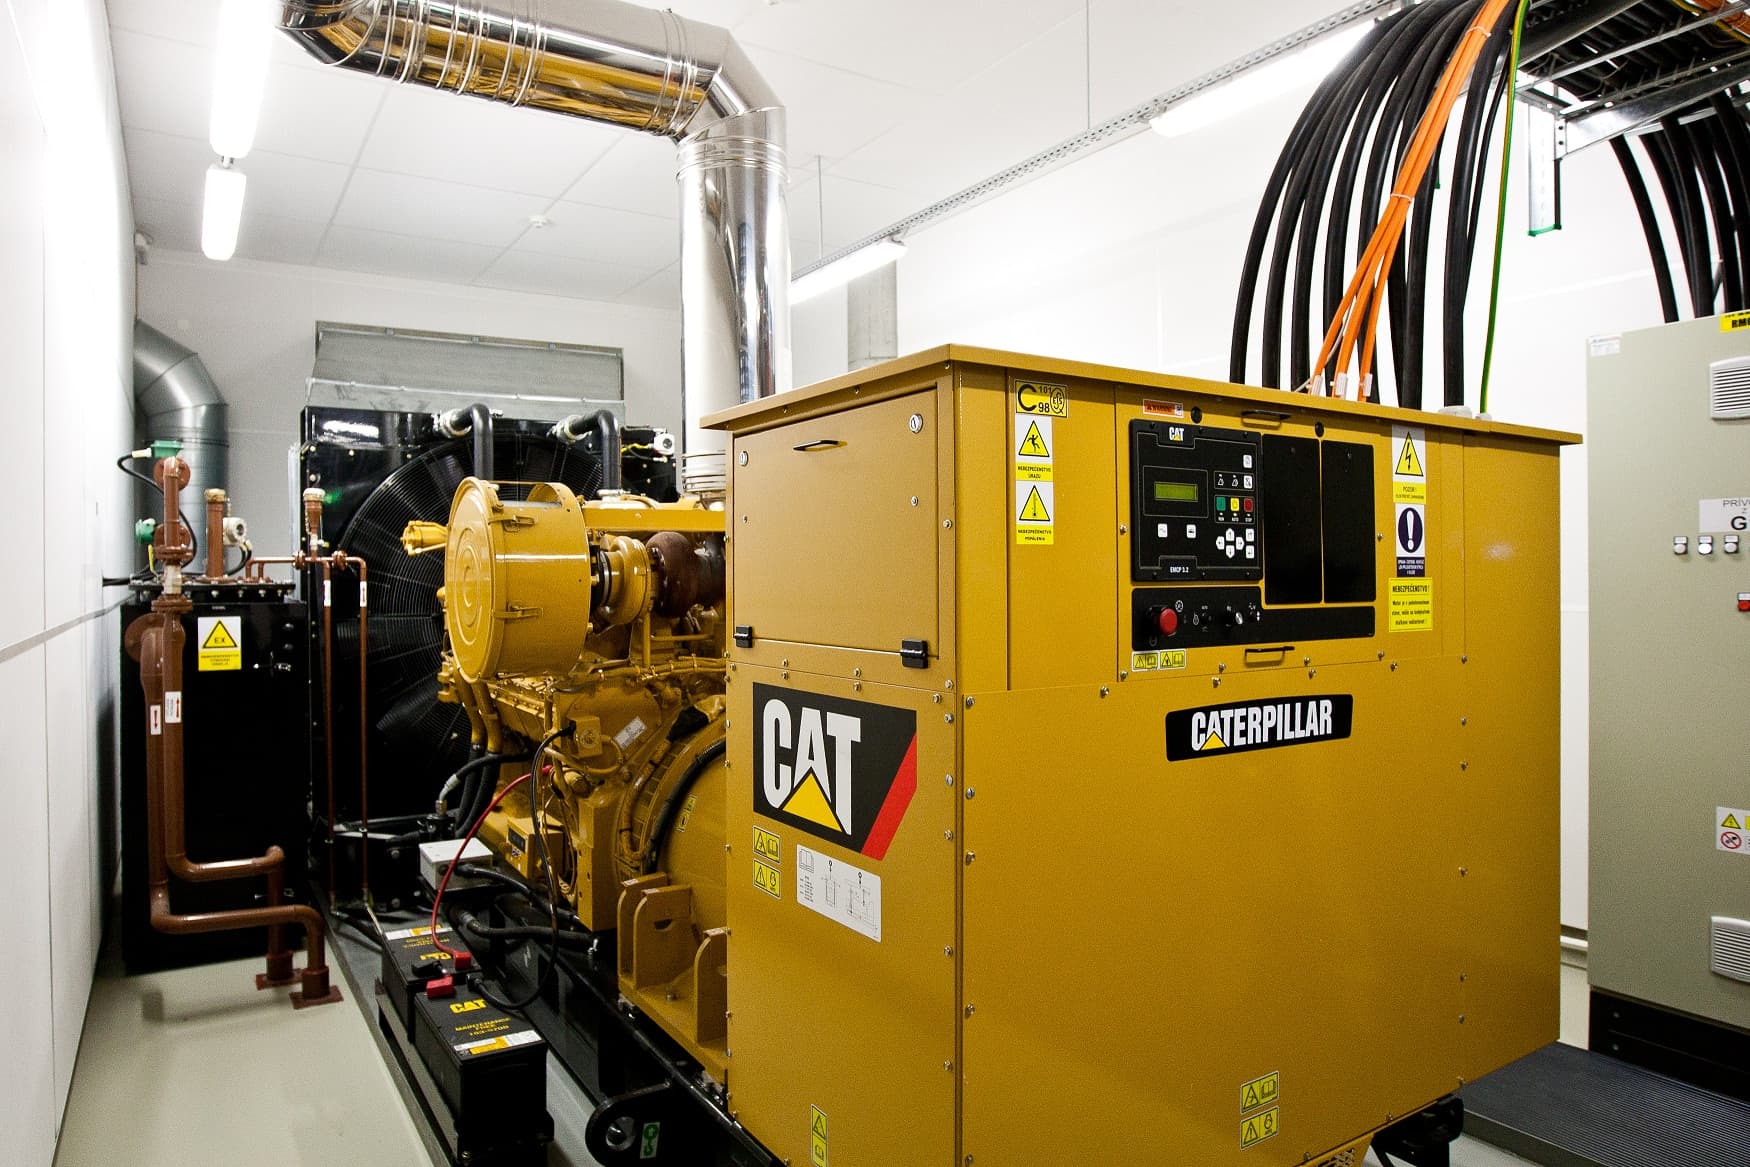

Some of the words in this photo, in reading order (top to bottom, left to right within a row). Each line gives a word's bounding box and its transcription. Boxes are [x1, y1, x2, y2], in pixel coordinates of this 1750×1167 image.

[1038, 402, 1050, 413] 98
[1169, 426, 1185, 442] CAT
[1723, 498, 1750, 508] PRÍV
[1191, 699, 1333, 751] CATERPILLAR
[763, 699, 861, 836] CAT
[449, 998, 487, 1014] CAT
